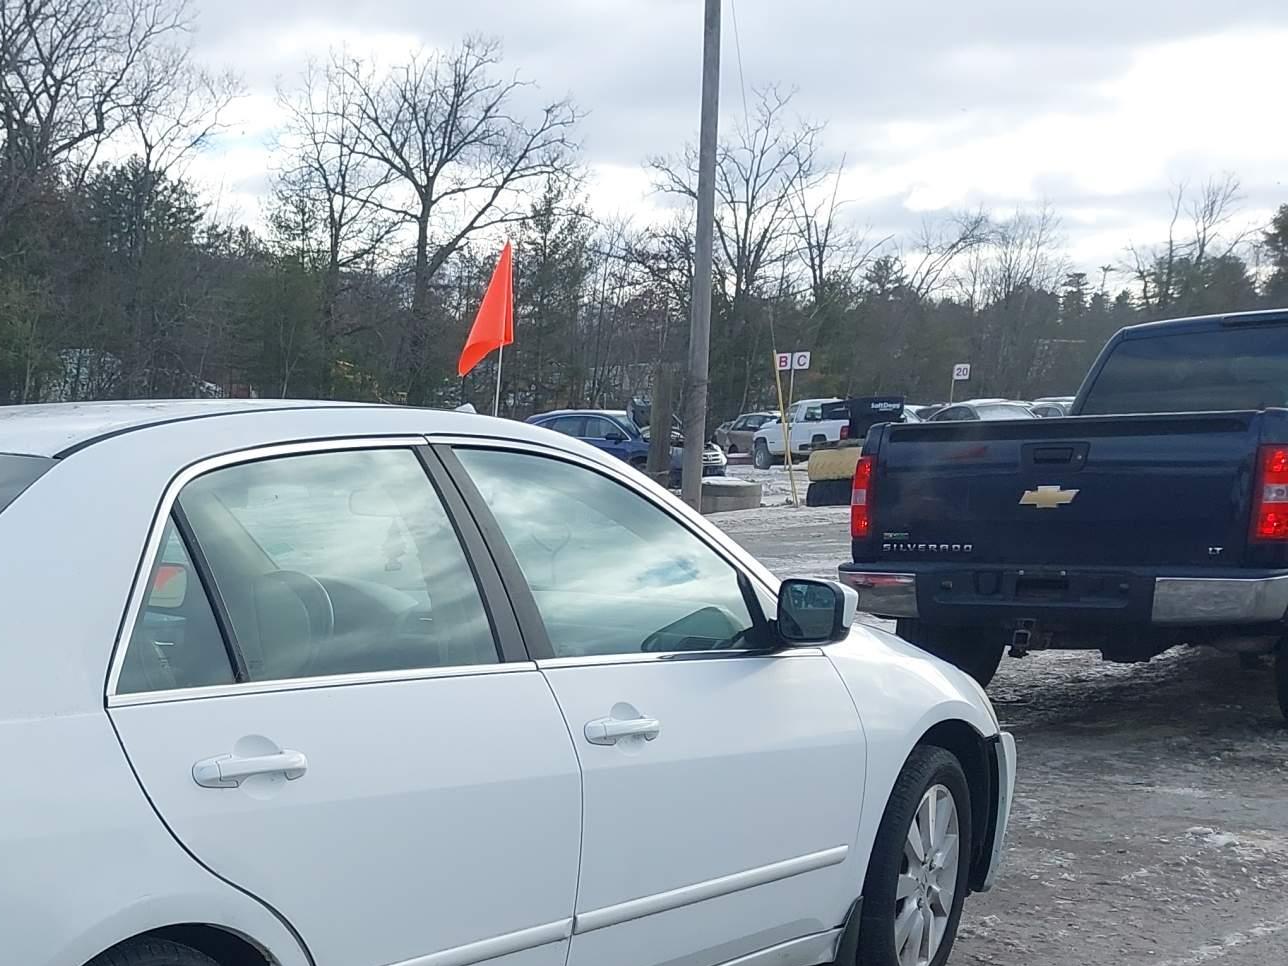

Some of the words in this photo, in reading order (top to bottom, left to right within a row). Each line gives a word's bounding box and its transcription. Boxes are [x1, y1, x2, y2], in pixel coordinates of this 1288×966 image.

[778, 355, 788, 368] B
[797, 354, 807, 366] C
[955, 367, 969, 377] 20
[882, 543, 973, 553] SILVERADO
[1208, 546, 1224, 556] LT
